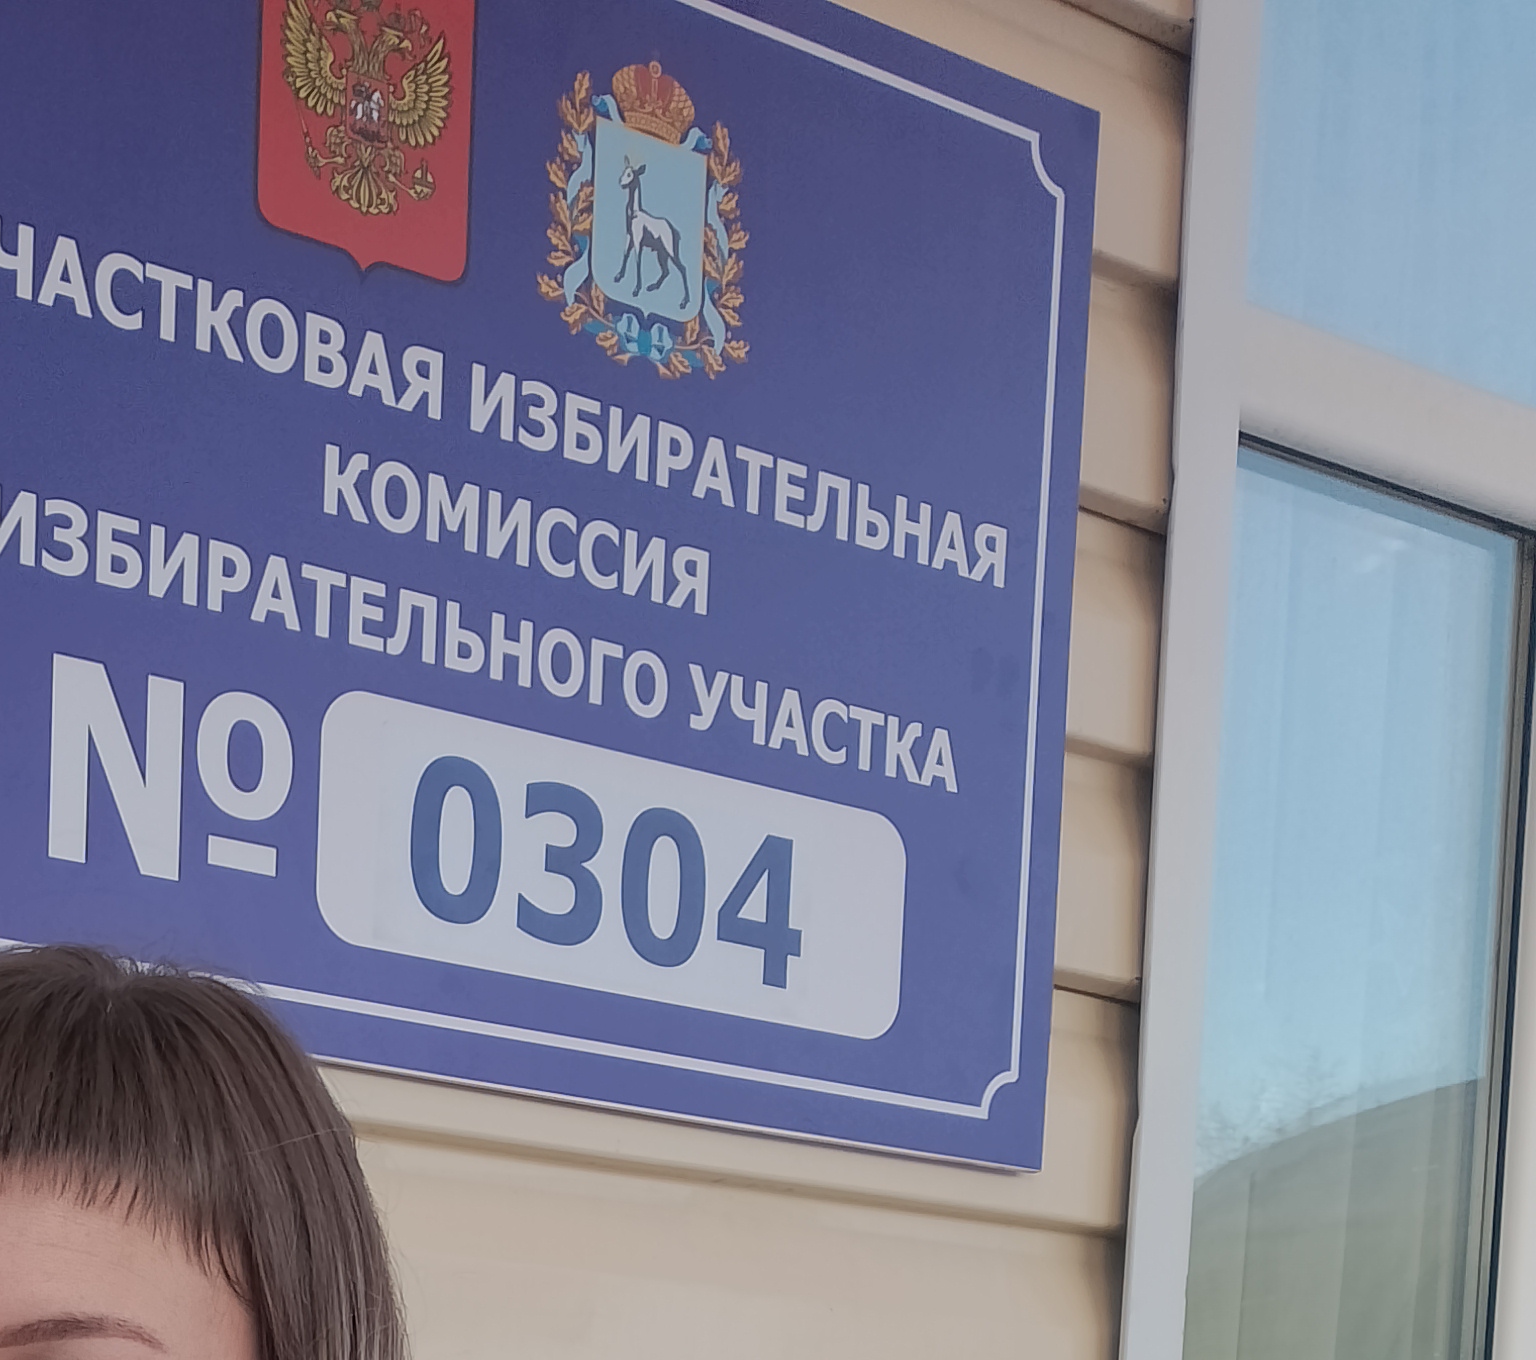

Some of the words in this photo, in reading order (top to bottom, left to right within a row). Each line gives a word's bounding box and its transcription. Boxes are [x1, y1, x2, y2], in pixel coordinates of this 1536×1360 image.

[322, 443, 711, 616] КОМИССИЯ
[468, 362, 1009, 589] ИЗБИРАТЕЛЬНАЯ
[47, 652, 295, 882] №
[409, 754, 804, 990] 0304
[688, 663, 959, 794] УЧАСТКА
